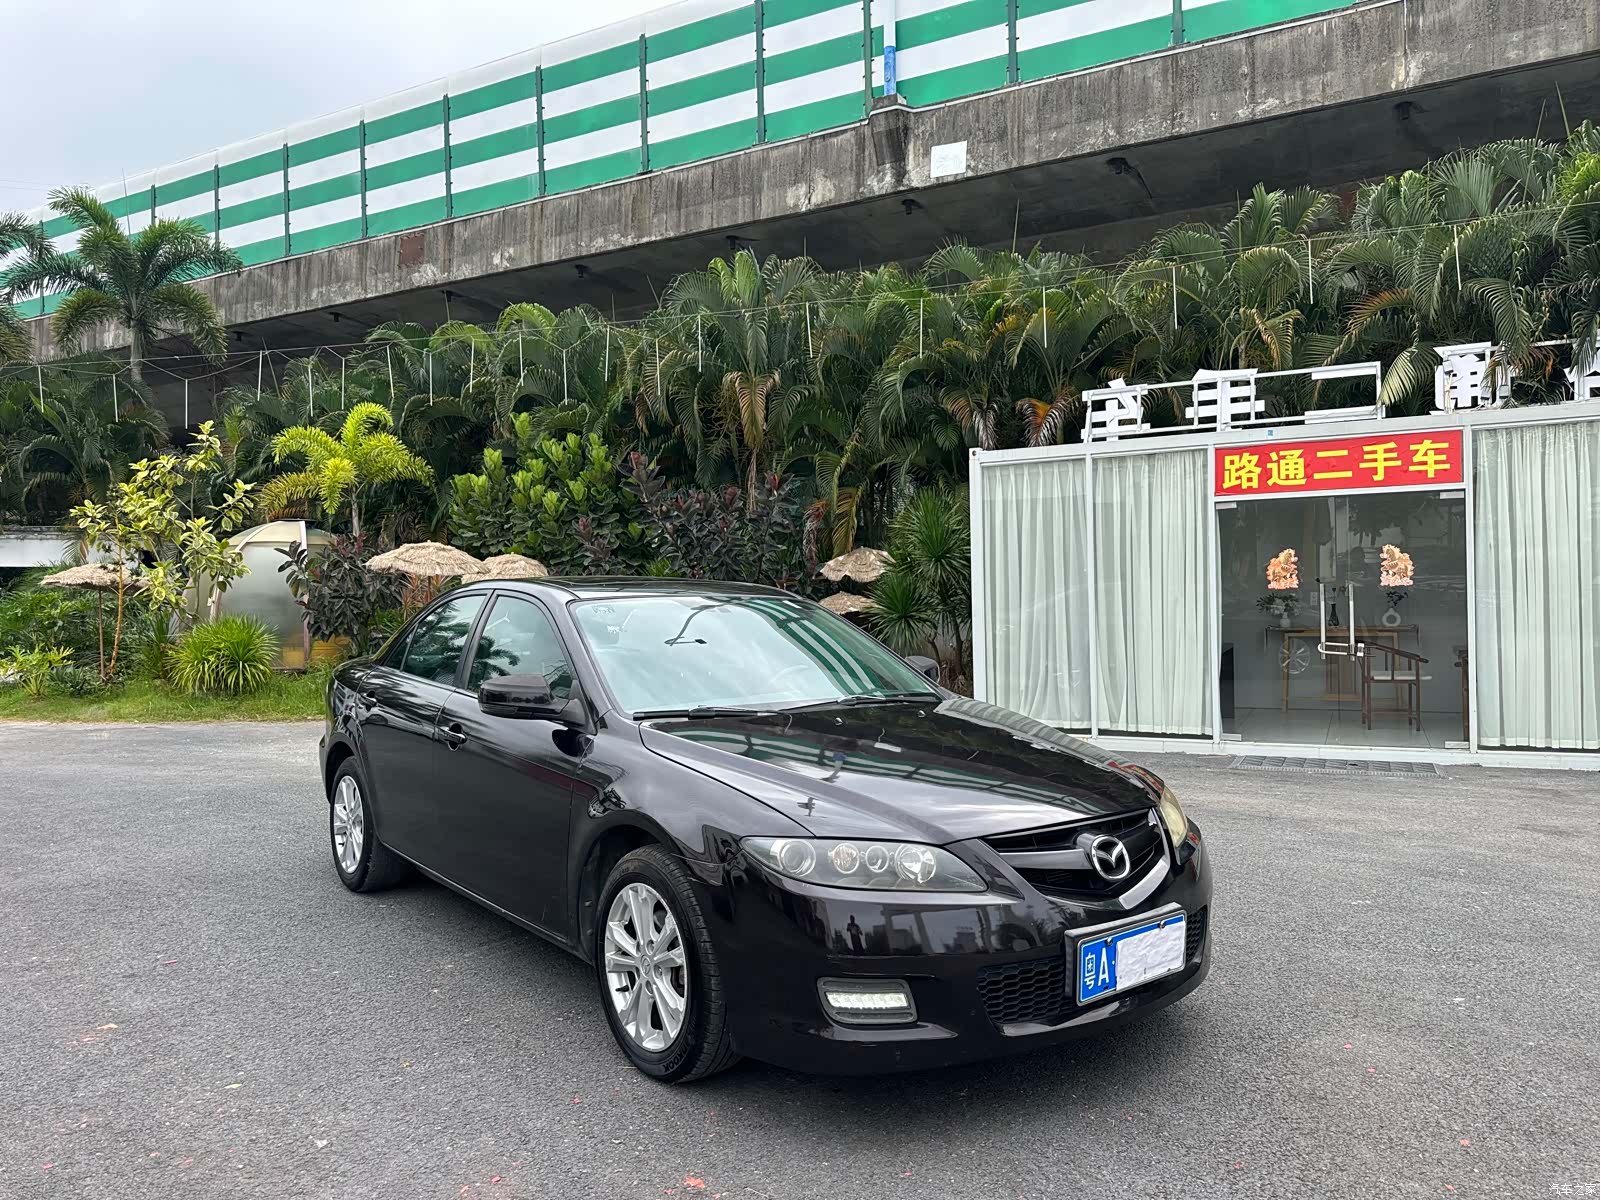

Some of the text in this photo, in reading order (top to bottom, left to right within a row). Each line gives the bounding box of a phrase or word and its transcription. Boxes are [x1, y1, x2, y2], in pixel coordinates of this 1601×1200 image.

[1222, 439, 1451, 490] 路通二手车
